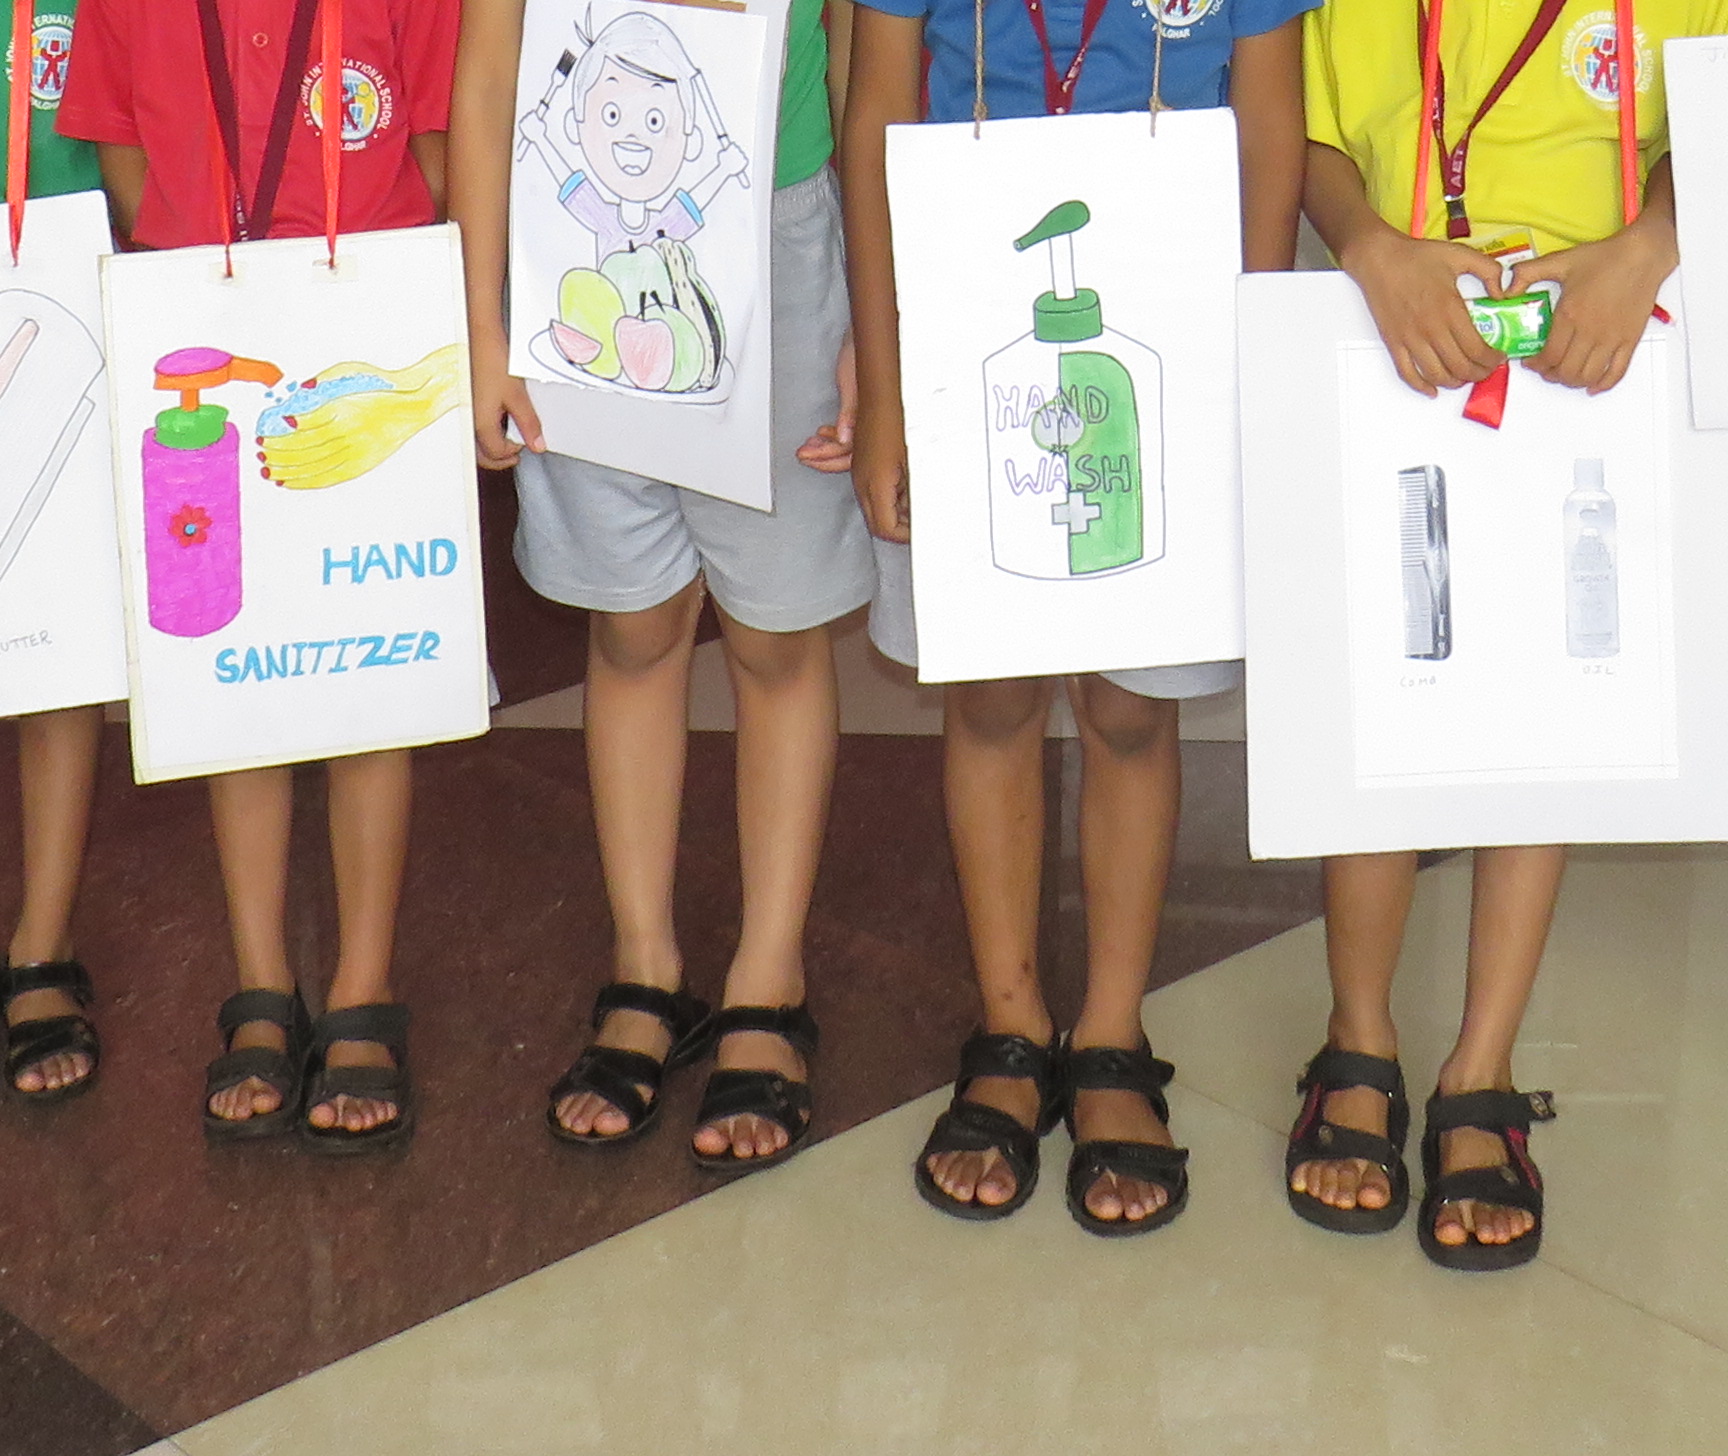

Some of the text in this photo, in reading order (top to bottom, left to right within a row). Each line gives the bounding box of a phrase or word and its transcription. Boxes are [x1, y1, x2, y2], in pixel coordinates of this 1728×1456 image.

[300, 74, 314, 106] JOHN
[377, 87, 393, 130] SCHOOL
[992, 383, 1110, 432] HAND
[1004, 453, 1132, 496] WASH
[322, 538, 458, 585] HAND
[214, 630, 441, 683] SANITIZER
